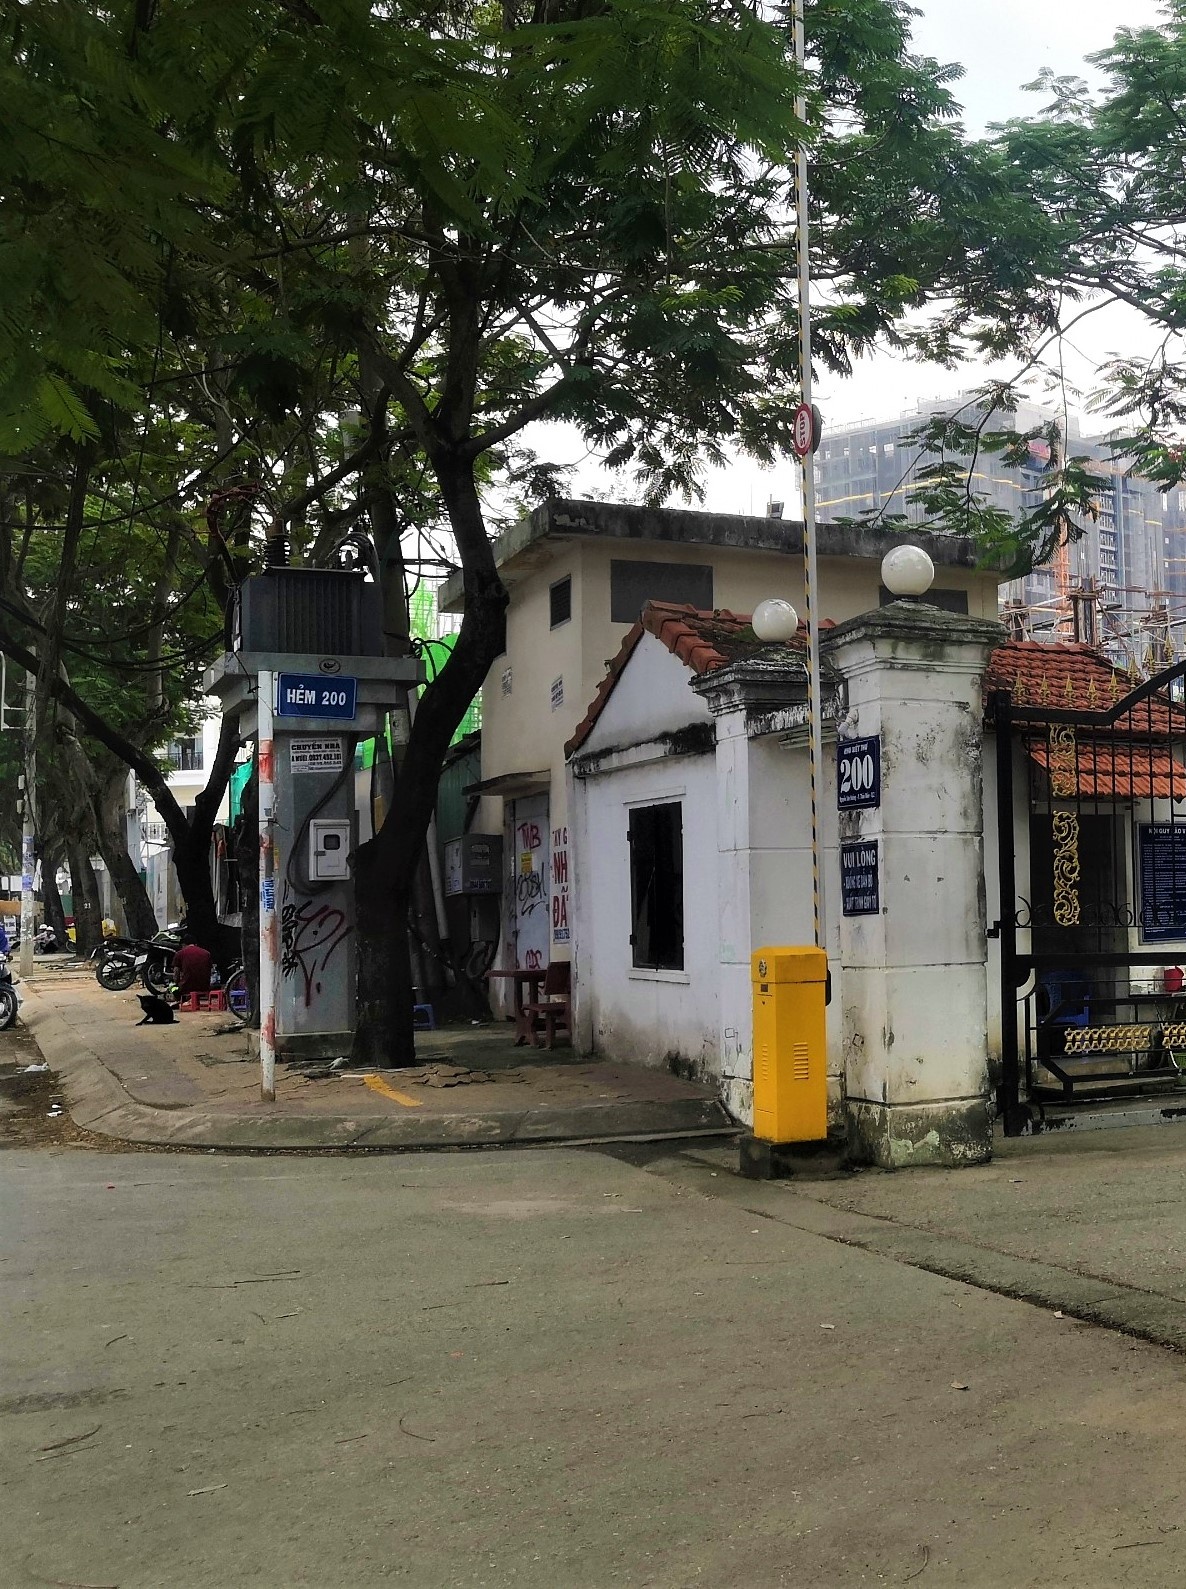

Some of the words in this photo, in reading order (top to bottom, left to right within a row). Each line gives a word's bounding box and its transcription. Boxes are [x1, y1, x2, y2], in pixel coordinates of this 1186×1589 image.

[286, 684, 316, 705] HẺM
[321, 691, 347, 706] 200
[840, 754, 874, 793] 200
[843, 851, 855, 869] VUI
[856, 846, 876, 868] LÒNG
